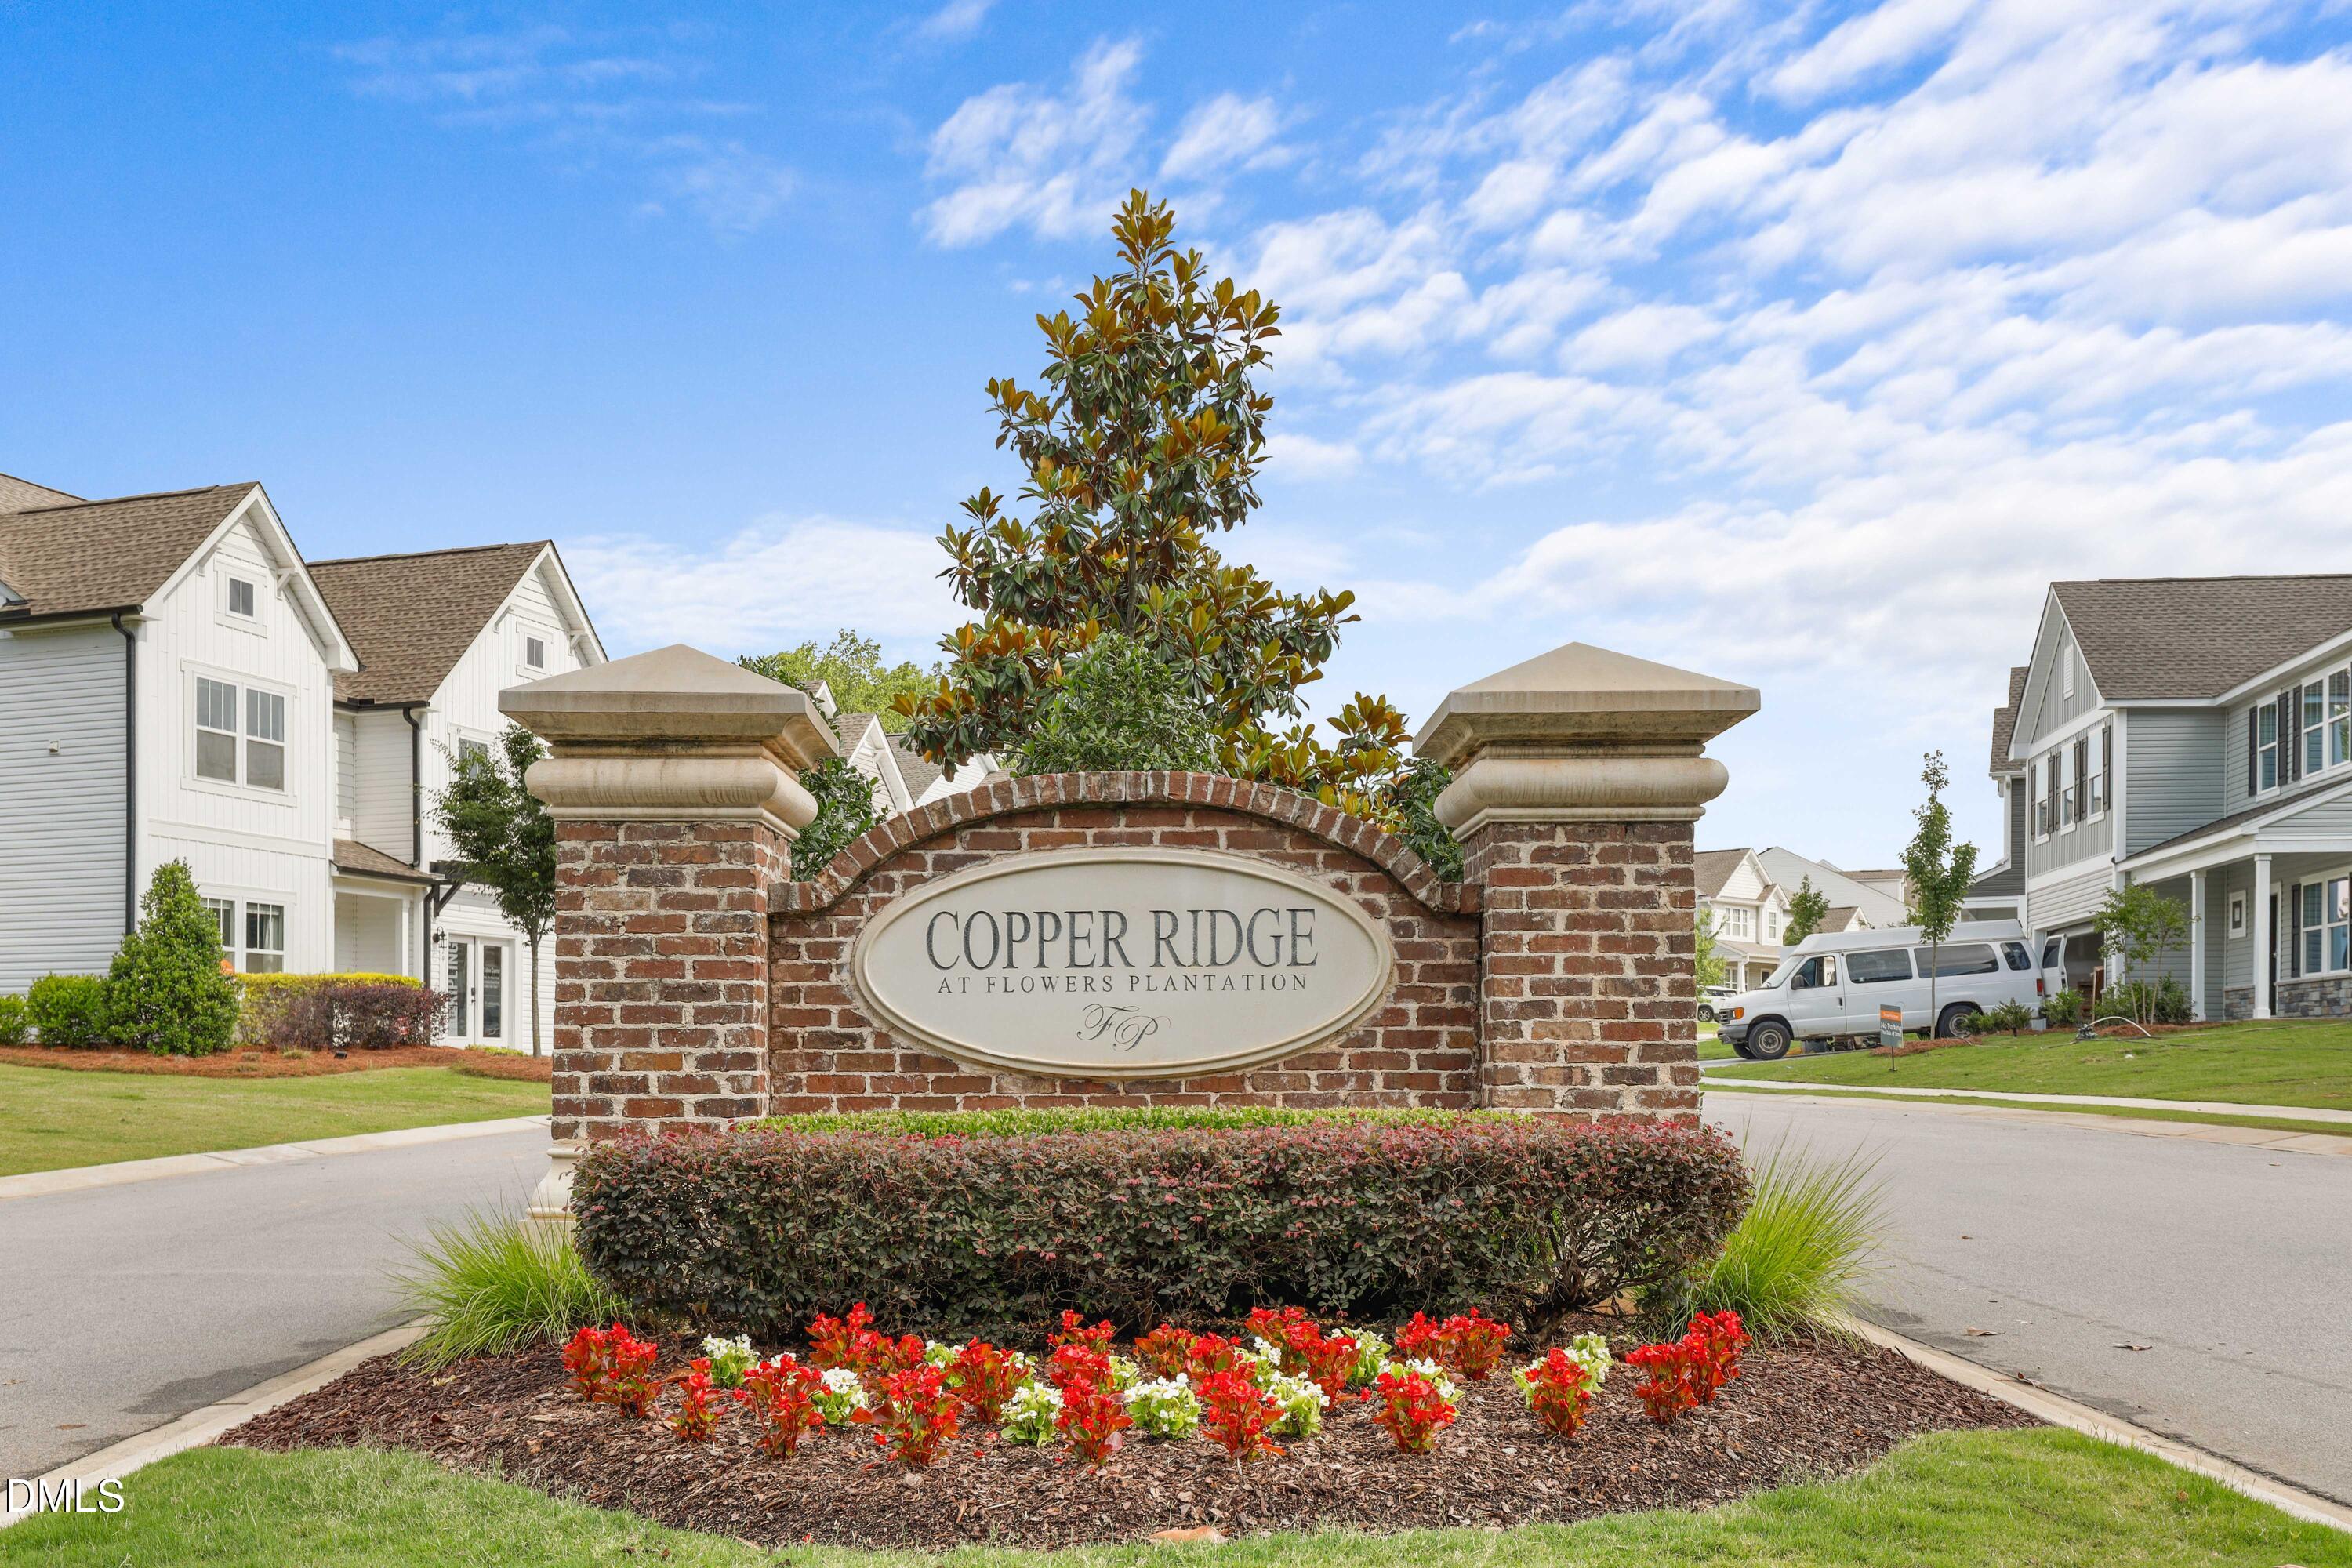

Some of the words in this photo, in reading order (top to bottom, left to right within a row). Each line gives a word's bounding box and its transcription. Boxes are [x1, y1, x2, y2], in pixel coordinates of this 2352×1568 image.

[926, 910, 1136, 971] COPPER
[1149, 908, 1319, 968] RIDGE
[938, 976, 971, 993] AT
[985, 975, 1113, 993] FLOWERS
[1128, 973, 1307, 993] PLANTATION
